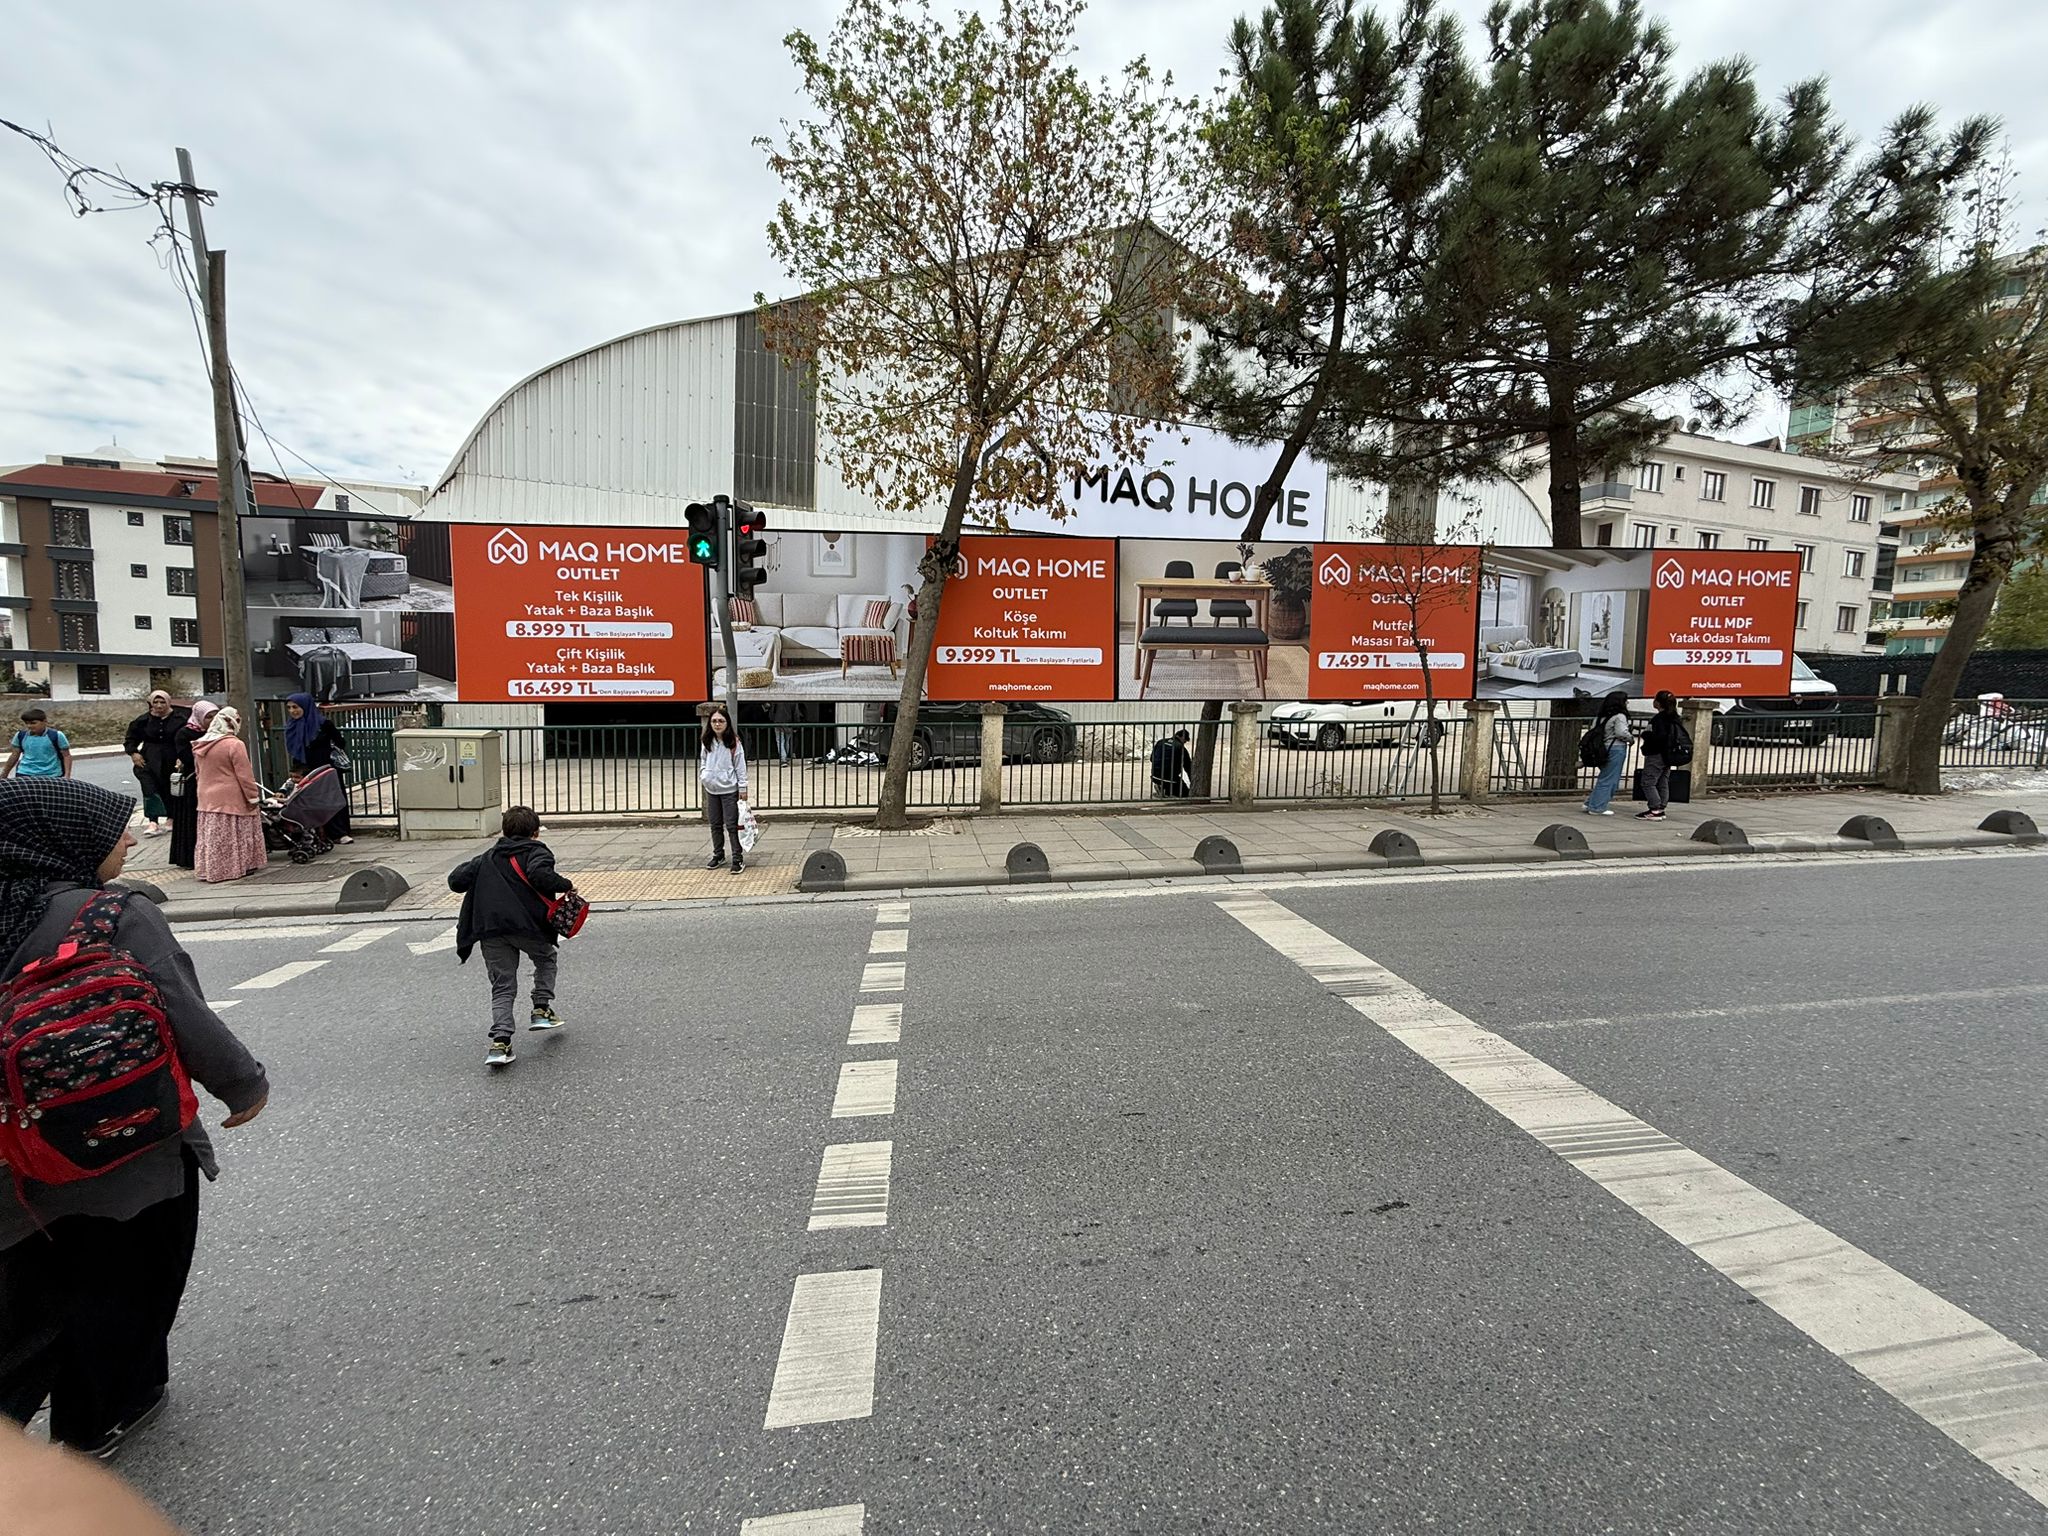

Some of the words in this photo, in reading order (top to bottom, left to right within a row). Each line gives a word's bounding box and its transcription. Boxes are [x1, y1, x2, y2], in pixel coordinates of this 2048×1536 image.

[1074, 464, 1174, 512] MAQ
[539, 541, 598, 562] MAQ
[607, 542, 684, 563] HOME
[557, 568, 620, 580] OUTLET
[978, 557, 1030, 578] MAQ
[1037, 559, 1106, 579] HOME
[1359, 564, 1406, 584] MAQ
[1411, 565, 1472, 584] HOME
[1691, 569, 1732, 586] MAQ
[1738, 570, 1792, 587] HOME
[555, 590, 579, 601] Tek
[583, 591, 623, 603] Kişilik
[992, 588, 1048, 600] OUTLET
[1701, 596, 1745, 607] OUTLET
[524, 604, 563, 616] Yatak
[580, 606, 611, 616] Baza
[615, 606, 654, 619] Başlık
[1004, 610, 1037, 625] Köşe
[515, 623, 565, 636] 8.999
[570, 624, 590, 636] TL
[1690, 617, 1721, 628] FULL
[1725, 618, 1753, 629] MDF
[974, 627, 1019, 638] Koltuk
[1022, 628, 1066, 639] Takımı
[1670, 633, 1700, 643] Yatak
[1702, 633, 1733, 643] Odası
[1736, 634, 1770, 644] Takımı
[1352, 636, 1392, 646] Masası
[1396, 636, 1434, 646] Takmı
[556, 648, 582, 661] Çift
[586, 649, 625, 662] Kişilik
[946, 648, 995, 662] 9.999
[1000, 649, 1020, 662] TL
[1327, 654, 1369, 667] 7.499
[1373, 655, 1391, 667] TL
[1686, 651, 1732, 663] 39.999
[1736, 652, 1751, 663] TL
[526, 662, 566, 674] Yatak
[582, 664, 613, 674] Baza
[616, 664, 655, 676] Başlık
[514, 682, 573, 695] 16.499
[578, 682, 597, 695] TL
[989, 684, 1052, 692] maqhome.com
[1363, 683, 1419, 691] maqhome.com
